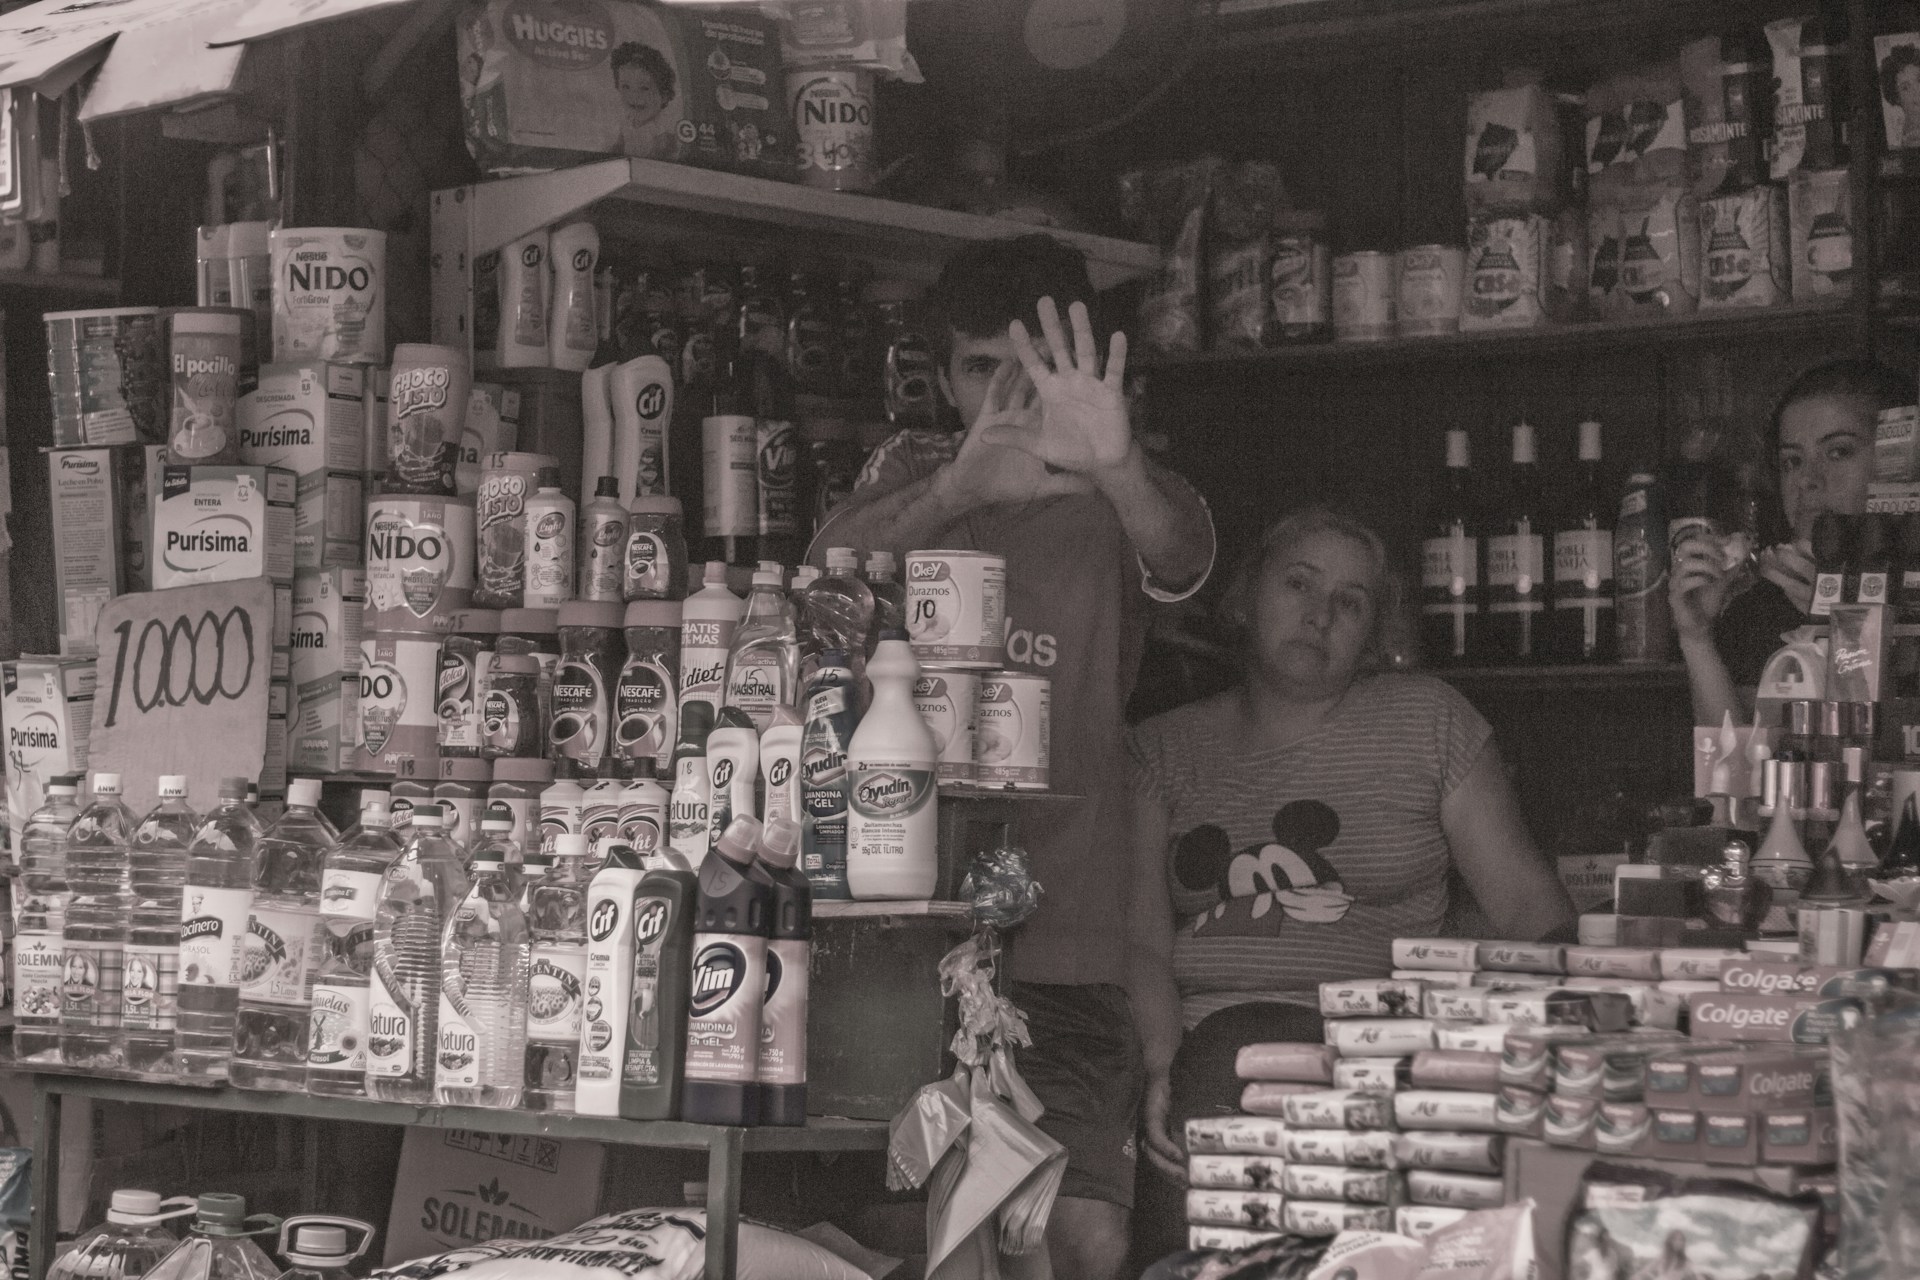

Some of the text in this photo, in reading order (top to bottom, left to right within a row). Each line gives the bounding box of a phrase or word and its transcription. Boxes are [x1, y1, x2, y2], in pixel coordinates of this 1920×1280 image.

[512, 13, 608, 50] HUGGIES
[804, 98, 872, 126] NIDO
[523, 247, 539, 265] Cif
[574, 252, 590, 269] Cif
[289, 263, 369, 292] NIDO
[174, 354, 236, 378] El pocillo
[391, 366, 448, 394] CHOCO
[638, 386, 661, 415] Cif
[240, 424, 311, 448] Purísima
[194, 498, 222, 507] ENTERA
[166, 530, 249, 553] Purísima
[369, 533, 442, 561] NIDO
[911, 561, 942, 580] Okey
[914, 600, 936, 624] 10
[103, 605, 254, 728] 10.000
[687, 662, 725, 687] diet
[819, 669, 842, 685] 15
[730, 683, 777, 696] MAGISTRAL
[681, 763, 693, 776] 18
[713, 765, 731, 786] Cif
[770, 762, 790, 784] Cif
[814, 799, 834, 809] GEL
[591, 904, 615, 938] Cif
[638, 906, 664, 940] Cif
[590, 952, 610, 962] Crema
[692, 964, 735, 998] Vim
[1696, 1002, 1790, 1029] Colgate
[1750, 1071, 1814, 1098] Colgate
